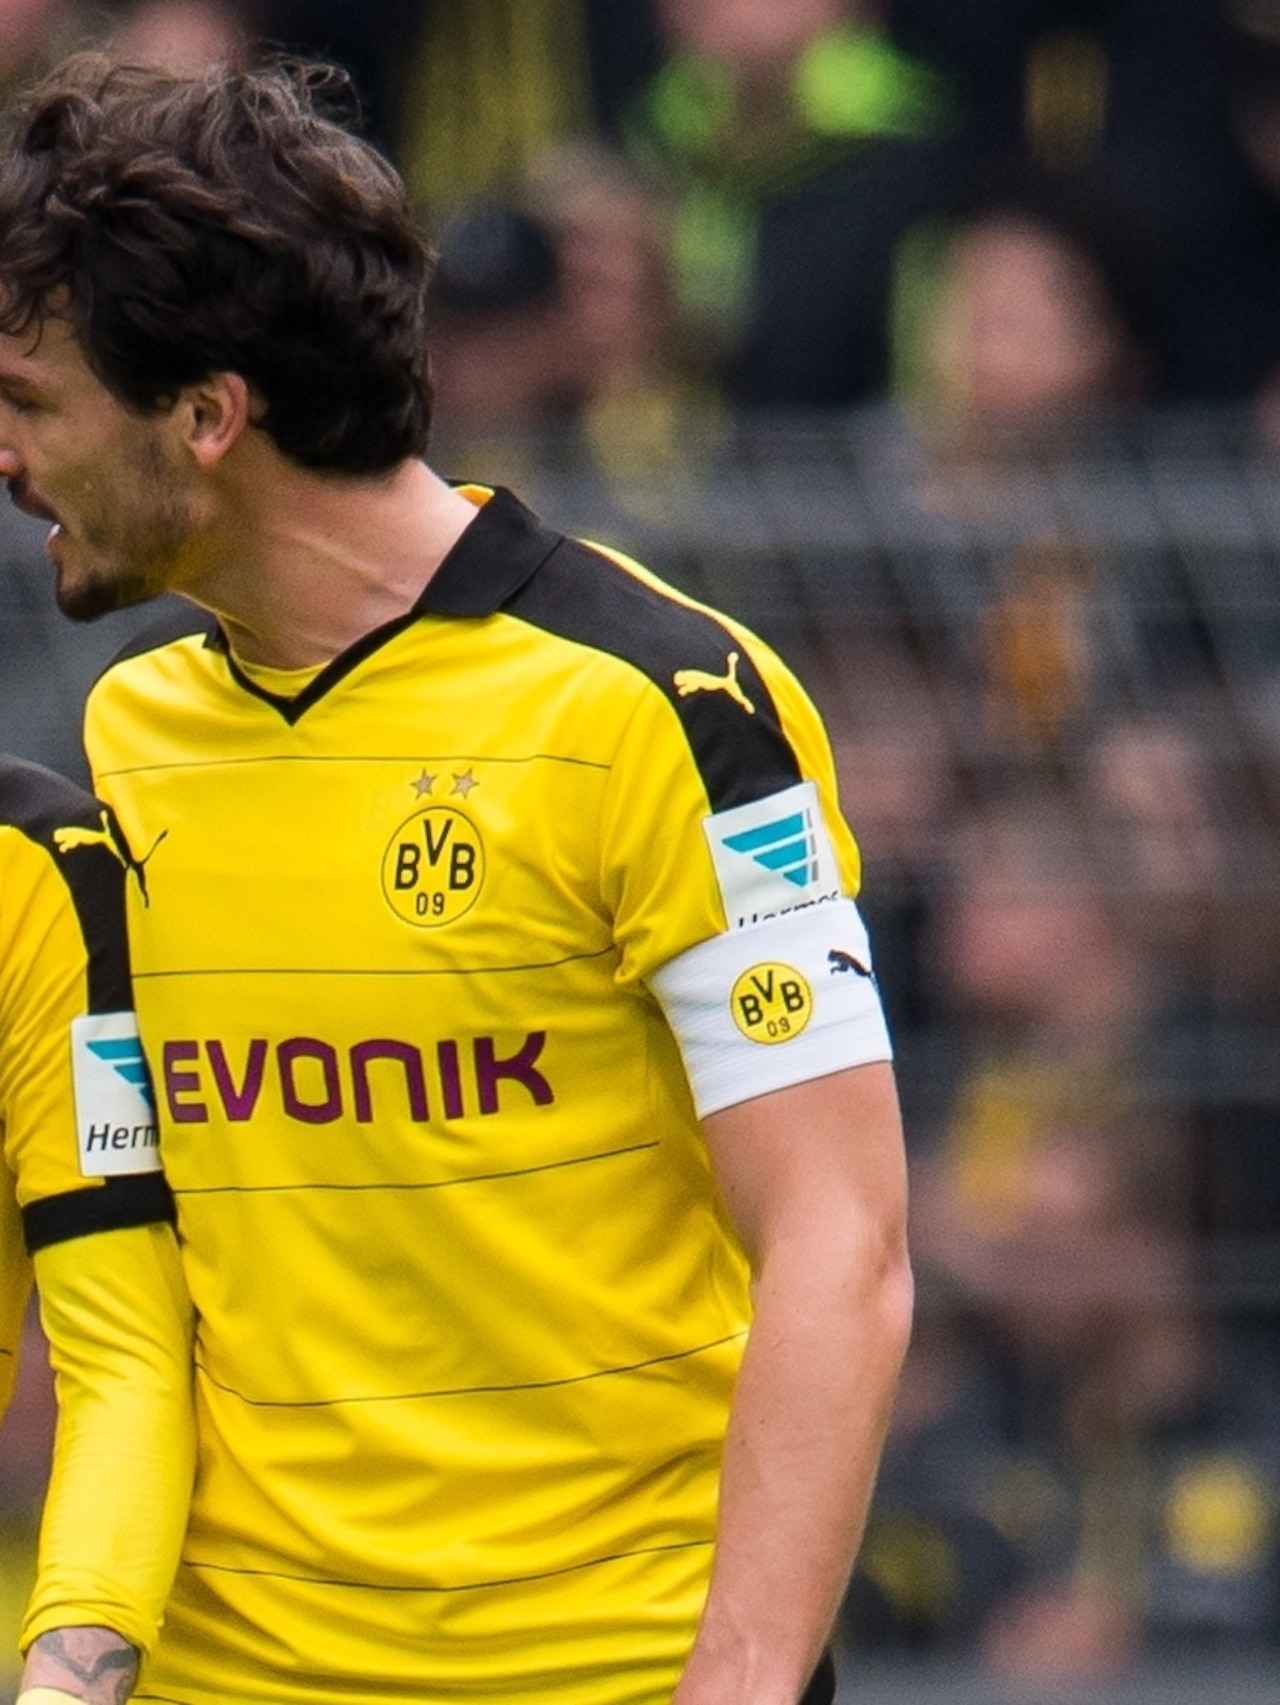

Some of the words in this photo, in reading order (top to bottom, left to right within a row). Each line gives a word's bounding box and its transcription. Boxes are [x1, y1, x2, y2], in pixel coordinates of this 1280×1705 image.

[394, 818, 476, 890] BVB
[416, 891, 445, 916] 09
[738, 969, 804, 1027] BVB
[163, 1030, 554, 1124] EVONIK
